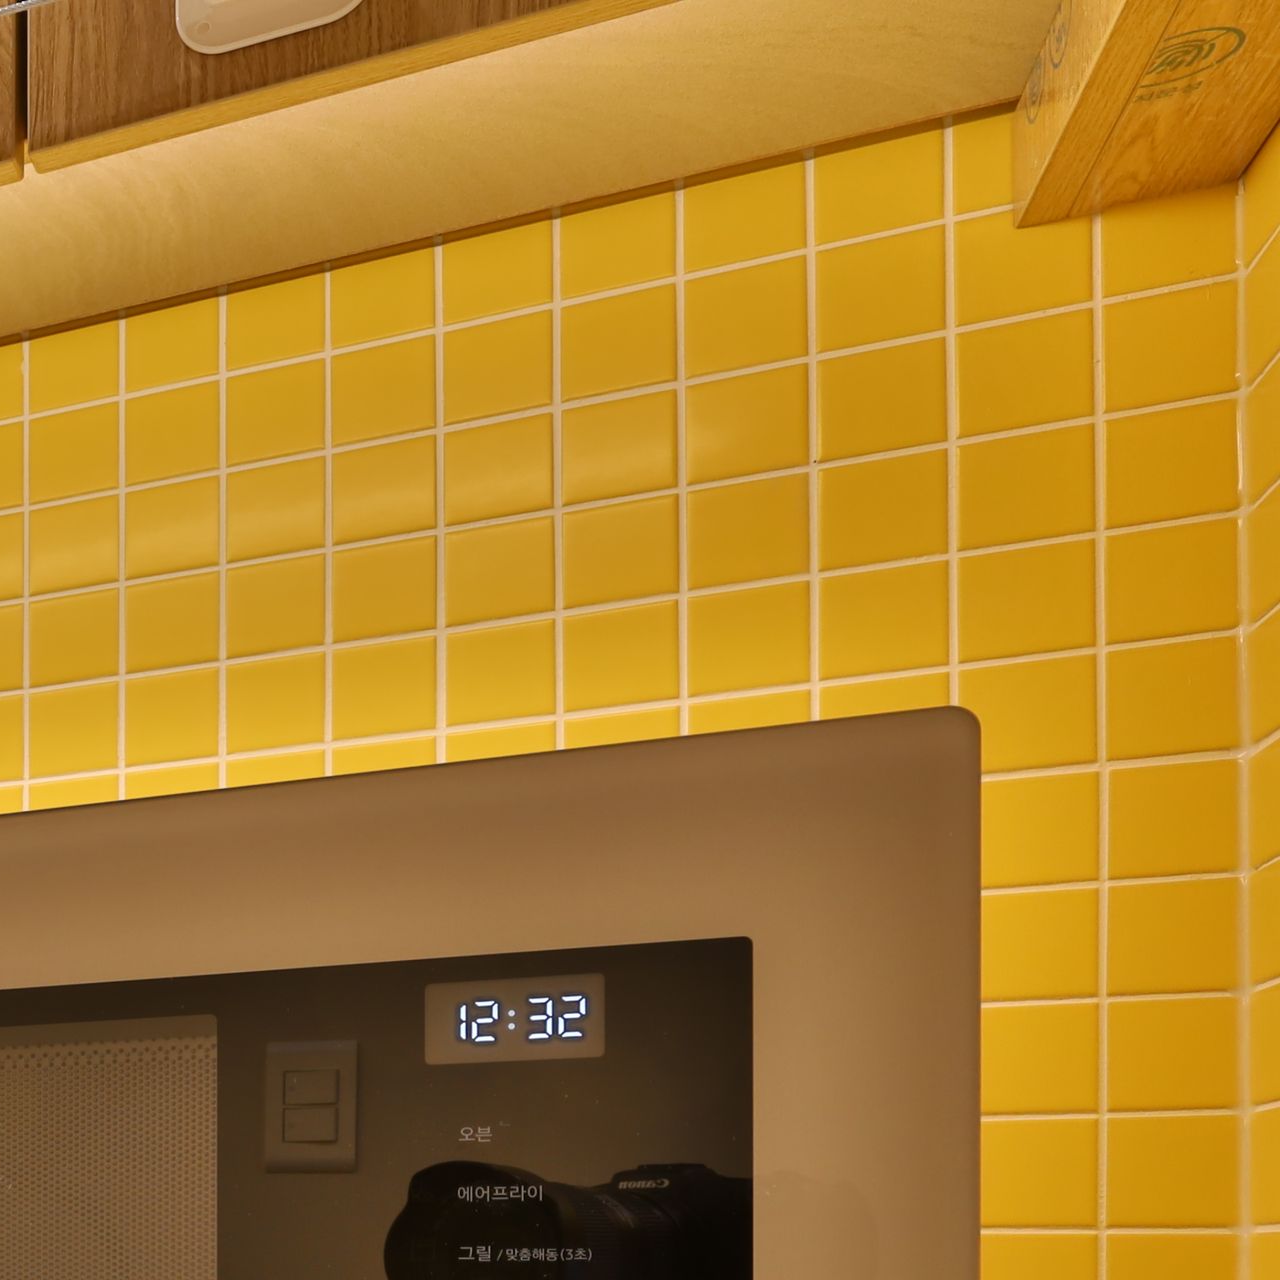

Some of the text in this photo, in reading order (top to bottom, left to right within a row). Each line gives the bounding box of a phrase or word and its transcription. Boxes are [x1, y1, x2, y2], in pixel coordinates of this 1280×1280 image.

[458, 994, 587, 1043] 12:32
[458, 1126, 493, 1142] 오븐
[457, 1184, 543, 1202] 에어프라이
[457, 1245, 492, 1262] 그릴
